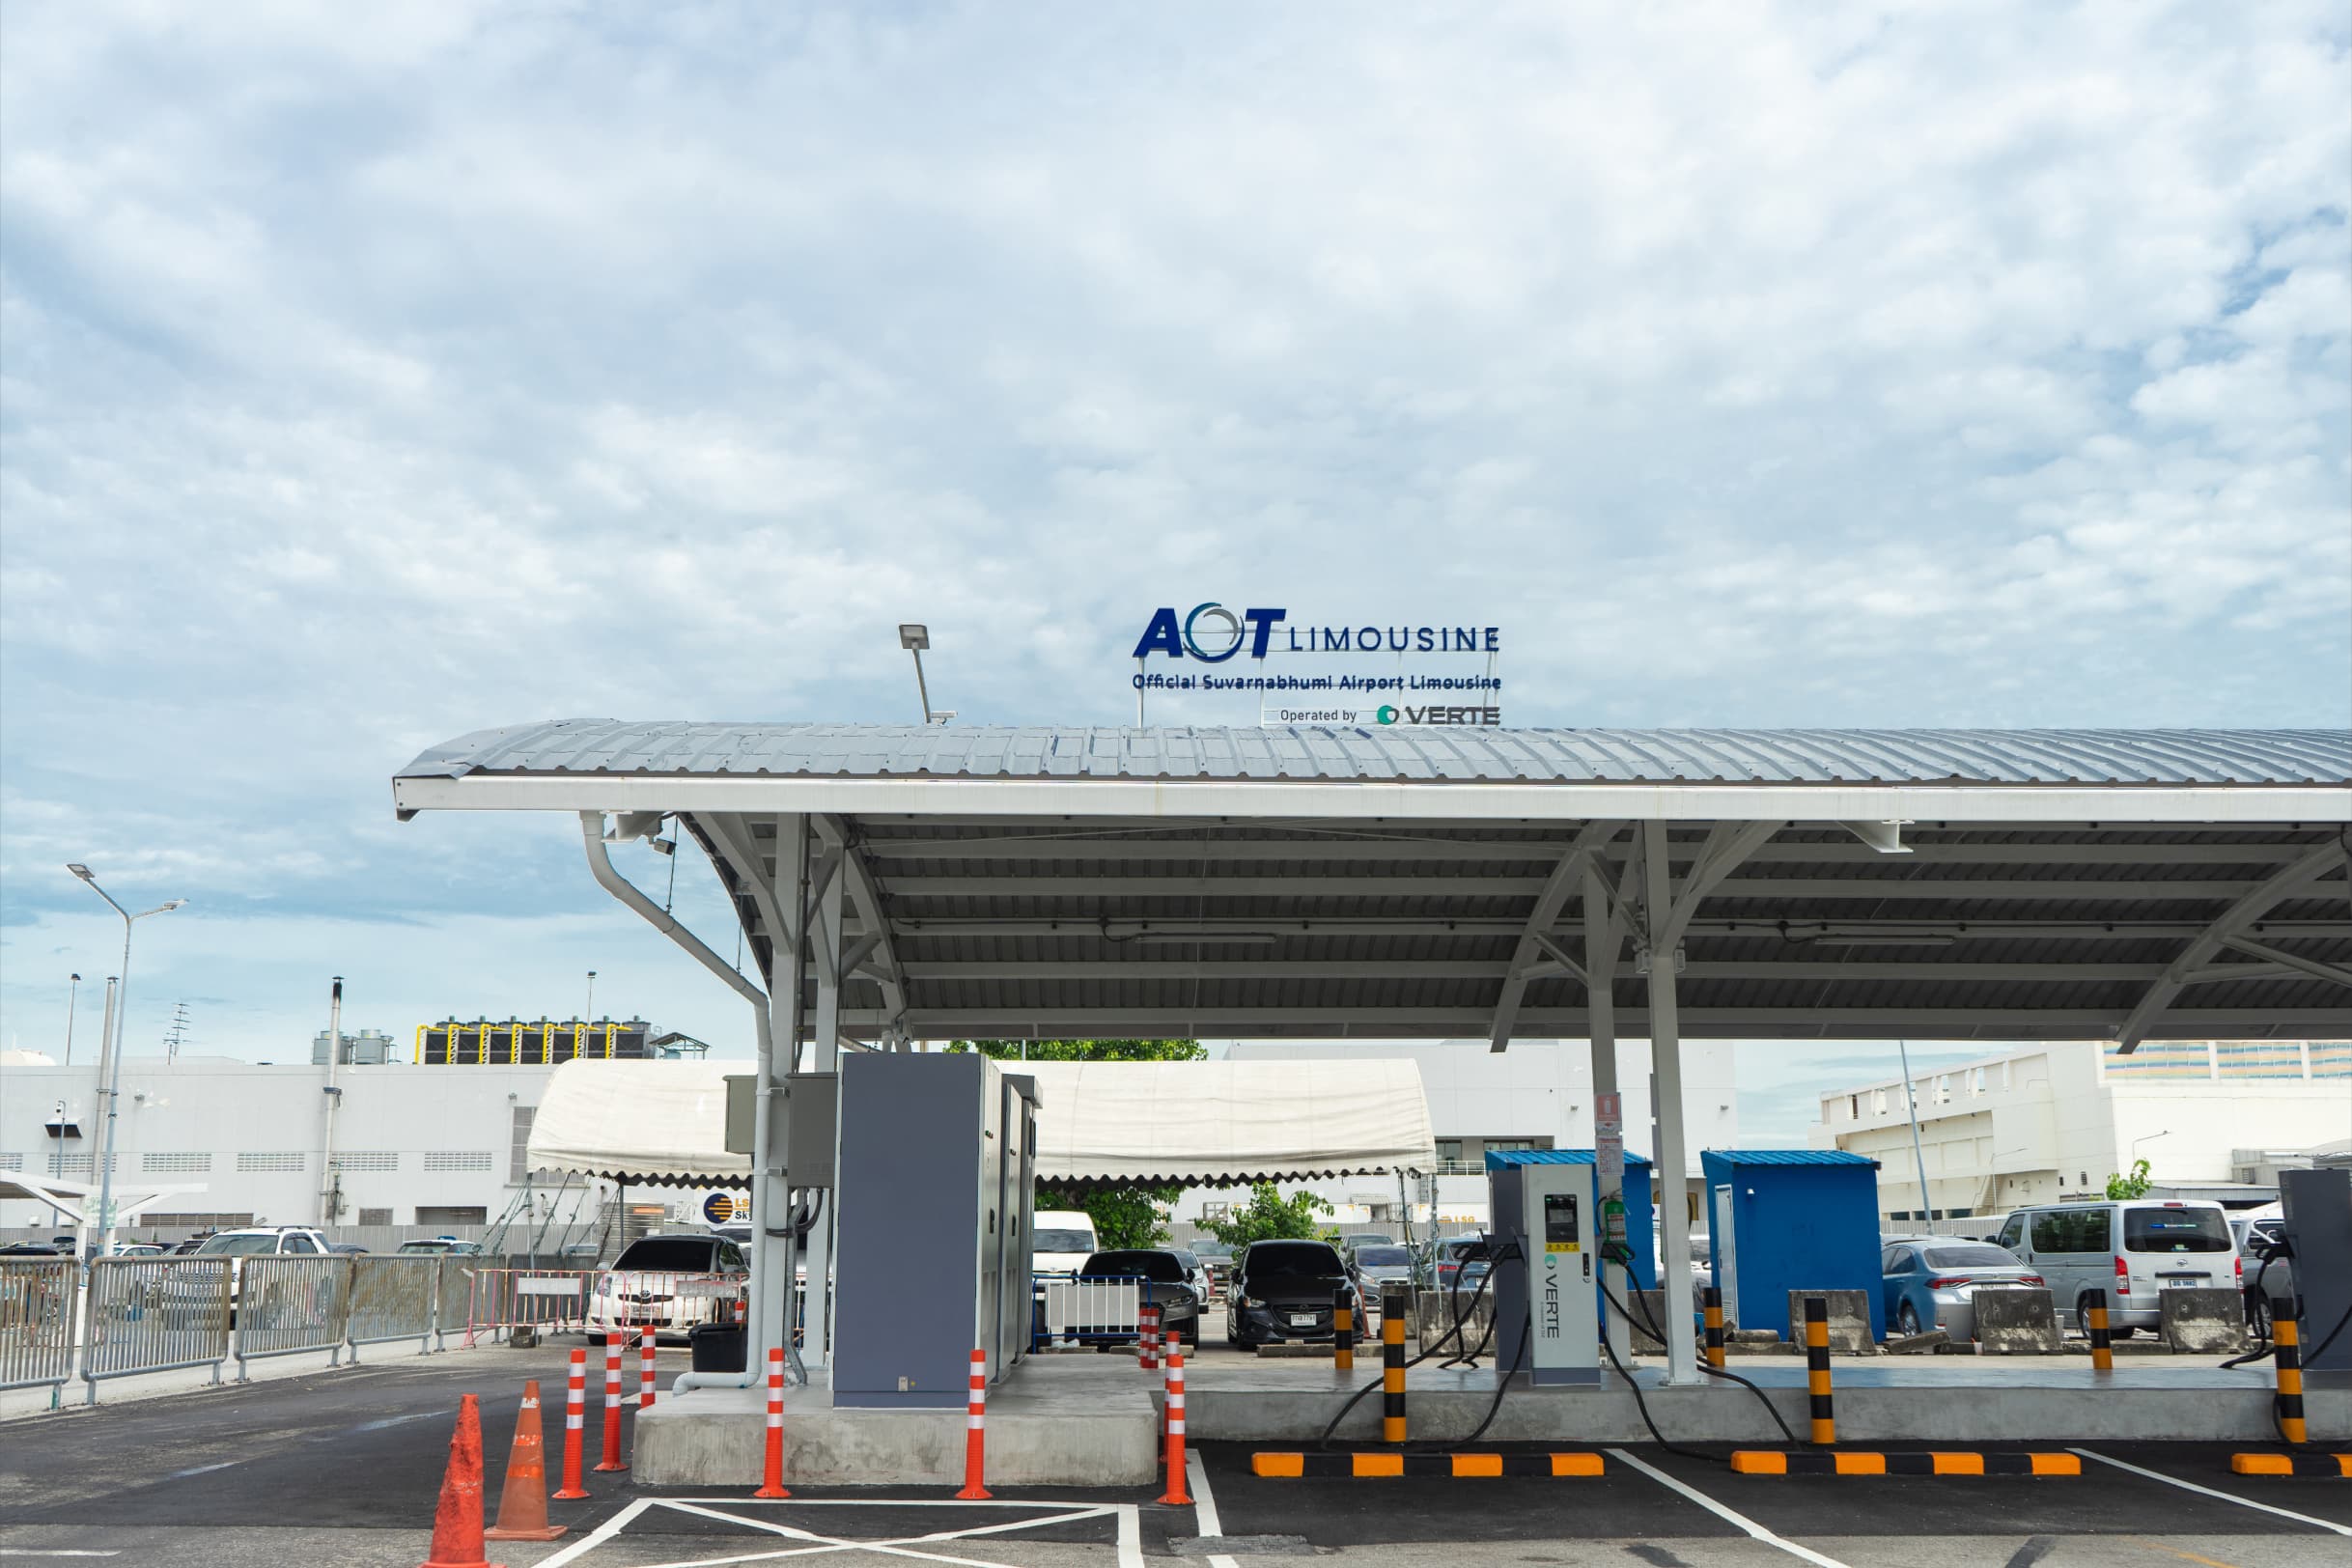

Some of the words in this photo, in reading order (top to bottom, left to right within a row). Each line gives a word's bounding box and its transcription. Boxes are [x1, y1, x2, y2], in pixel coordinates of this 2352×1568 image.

[1133, 602, 1286, 663] AOT
[1290, 627, 1498, 652] LIMOUSINE
[1133, 674, 1195, 689] Official
[1203, 674, 1331, 689] Suvarnabhumi
[1339, 675, 1404, 692] Airport
[1411, 675, 1501, 689] Limousine
[1280, 710, 1338, 722] Operated
[1343, 710, 1357, 722] by
[1405, 706, 1500, 725] VERTE
[735, 1198, 749, 1207] LS
[1546, 1274, 1559, 1338] VERTE
